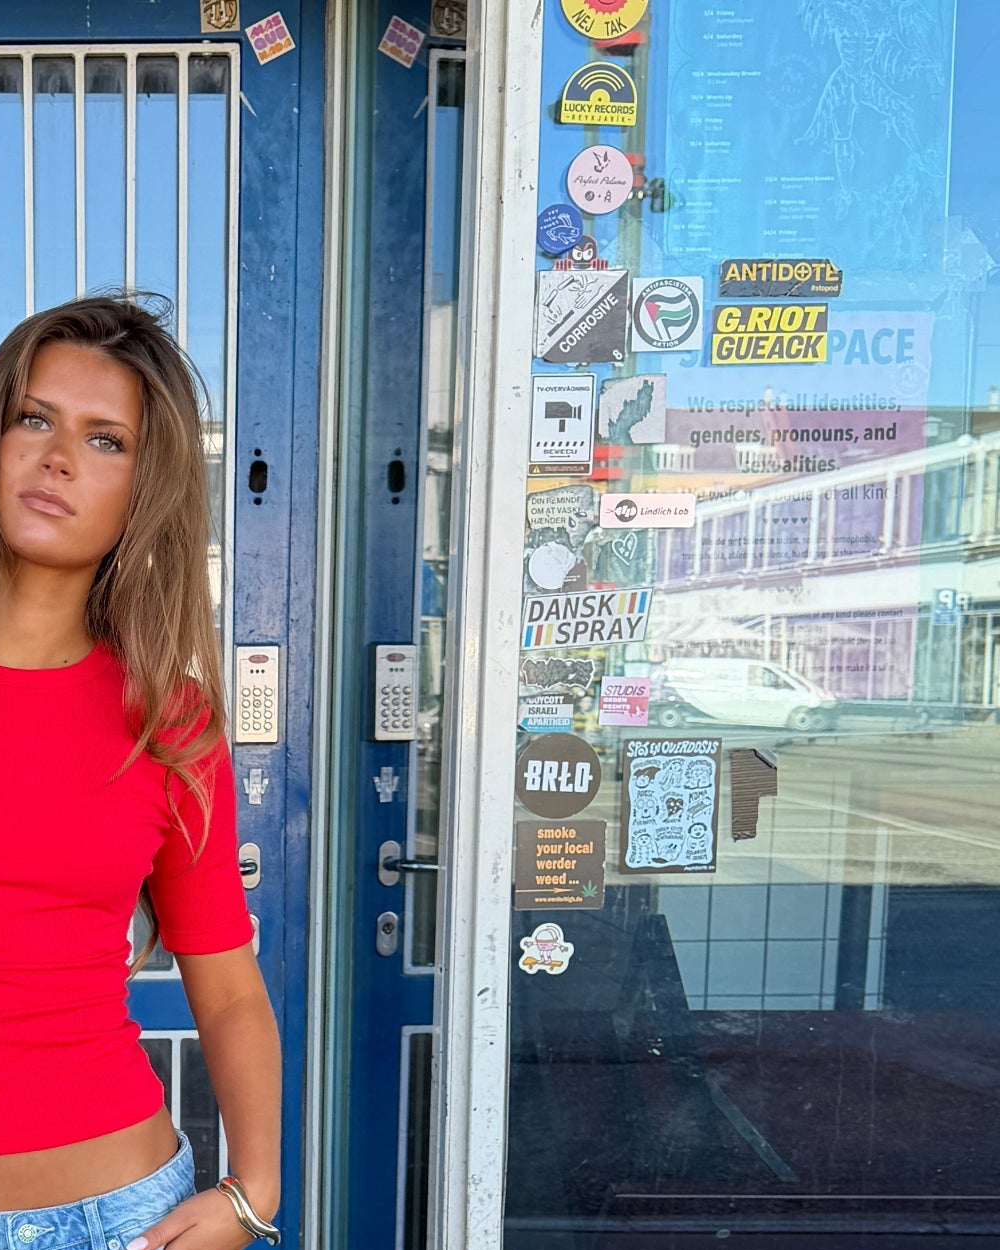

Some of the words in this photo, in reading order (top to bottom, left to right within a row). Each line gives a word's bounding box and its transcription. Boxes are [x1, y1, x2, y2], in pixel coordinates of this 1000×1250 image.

[250, 14, 281, 39] MAS
[571, 9, 595, 33] NEJ
[605, 17, 628, 36] TAK
[258, 37, 292, 61] NADA
[564, 103, 592, 113] LUCKY
[594, 105, 634, 114] RECORDS
[559, 292, 619, 353] CORROSIVE
[716, 306, 827, 333] G.RIOT
[612, 350, 623, 360] 8
[716, 334, 826, 361] GUEACK
[828, 327, 915, 366] PACE
[688, 397, 713, 413] We
[720, 396, 781, 417] respect
[786, 393, 807, 412] all
[812, 392, 902, 413] identities,
[690, 424, 766, 448] genders,
[771, 426, 859, 447] pronouns,
[863, 422, 897, 441] and
[842, 483, 858, 500] all
[532, 497, 545, 505] DIN
[674, 507, 689, 515] Lab
[528, 594, 616, 622] DANSK
[555, 616, 643, 644] SPRAY
[604, 685, 646, 696] STUDIS
[528, 707, 557, 715] ISRAELI
[528, 718, 571, 726] APARTHEID
[662, 740, 719, 755] OVERDOSIS
[523, 759, 593, 793] BRŁO
[537, 827, 576, 839] smoke
[536, 844, 562, 857] your
[565, 842, 594, 854] local
[536, 858, 577, 870] werder
[535, 873, 567, 885] weed
